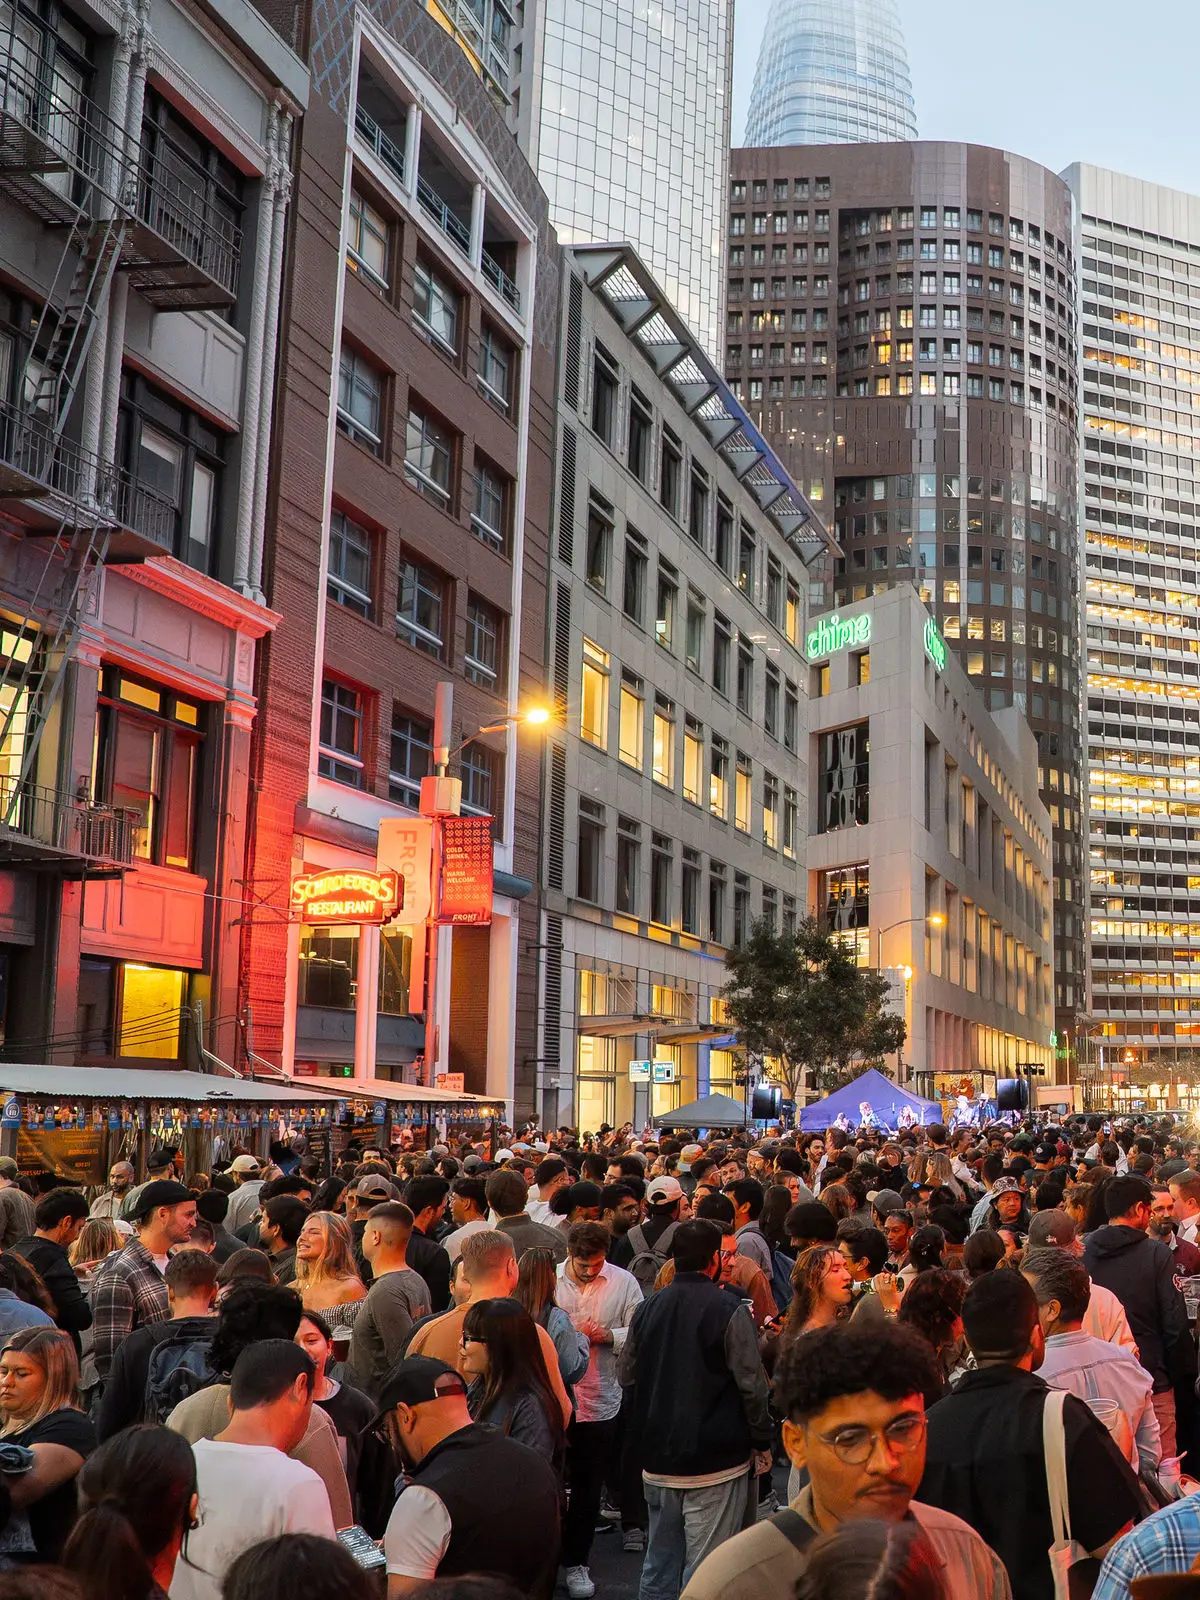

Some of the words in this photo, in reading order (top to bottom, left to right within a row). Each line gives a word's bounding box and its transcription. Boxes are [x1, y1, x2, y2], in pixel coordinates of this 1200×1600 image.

[807, 615, 872, 658] chime
[307, 900, 377, 916] RESTAURANT
[452, 913, 478, 922] FRONT
